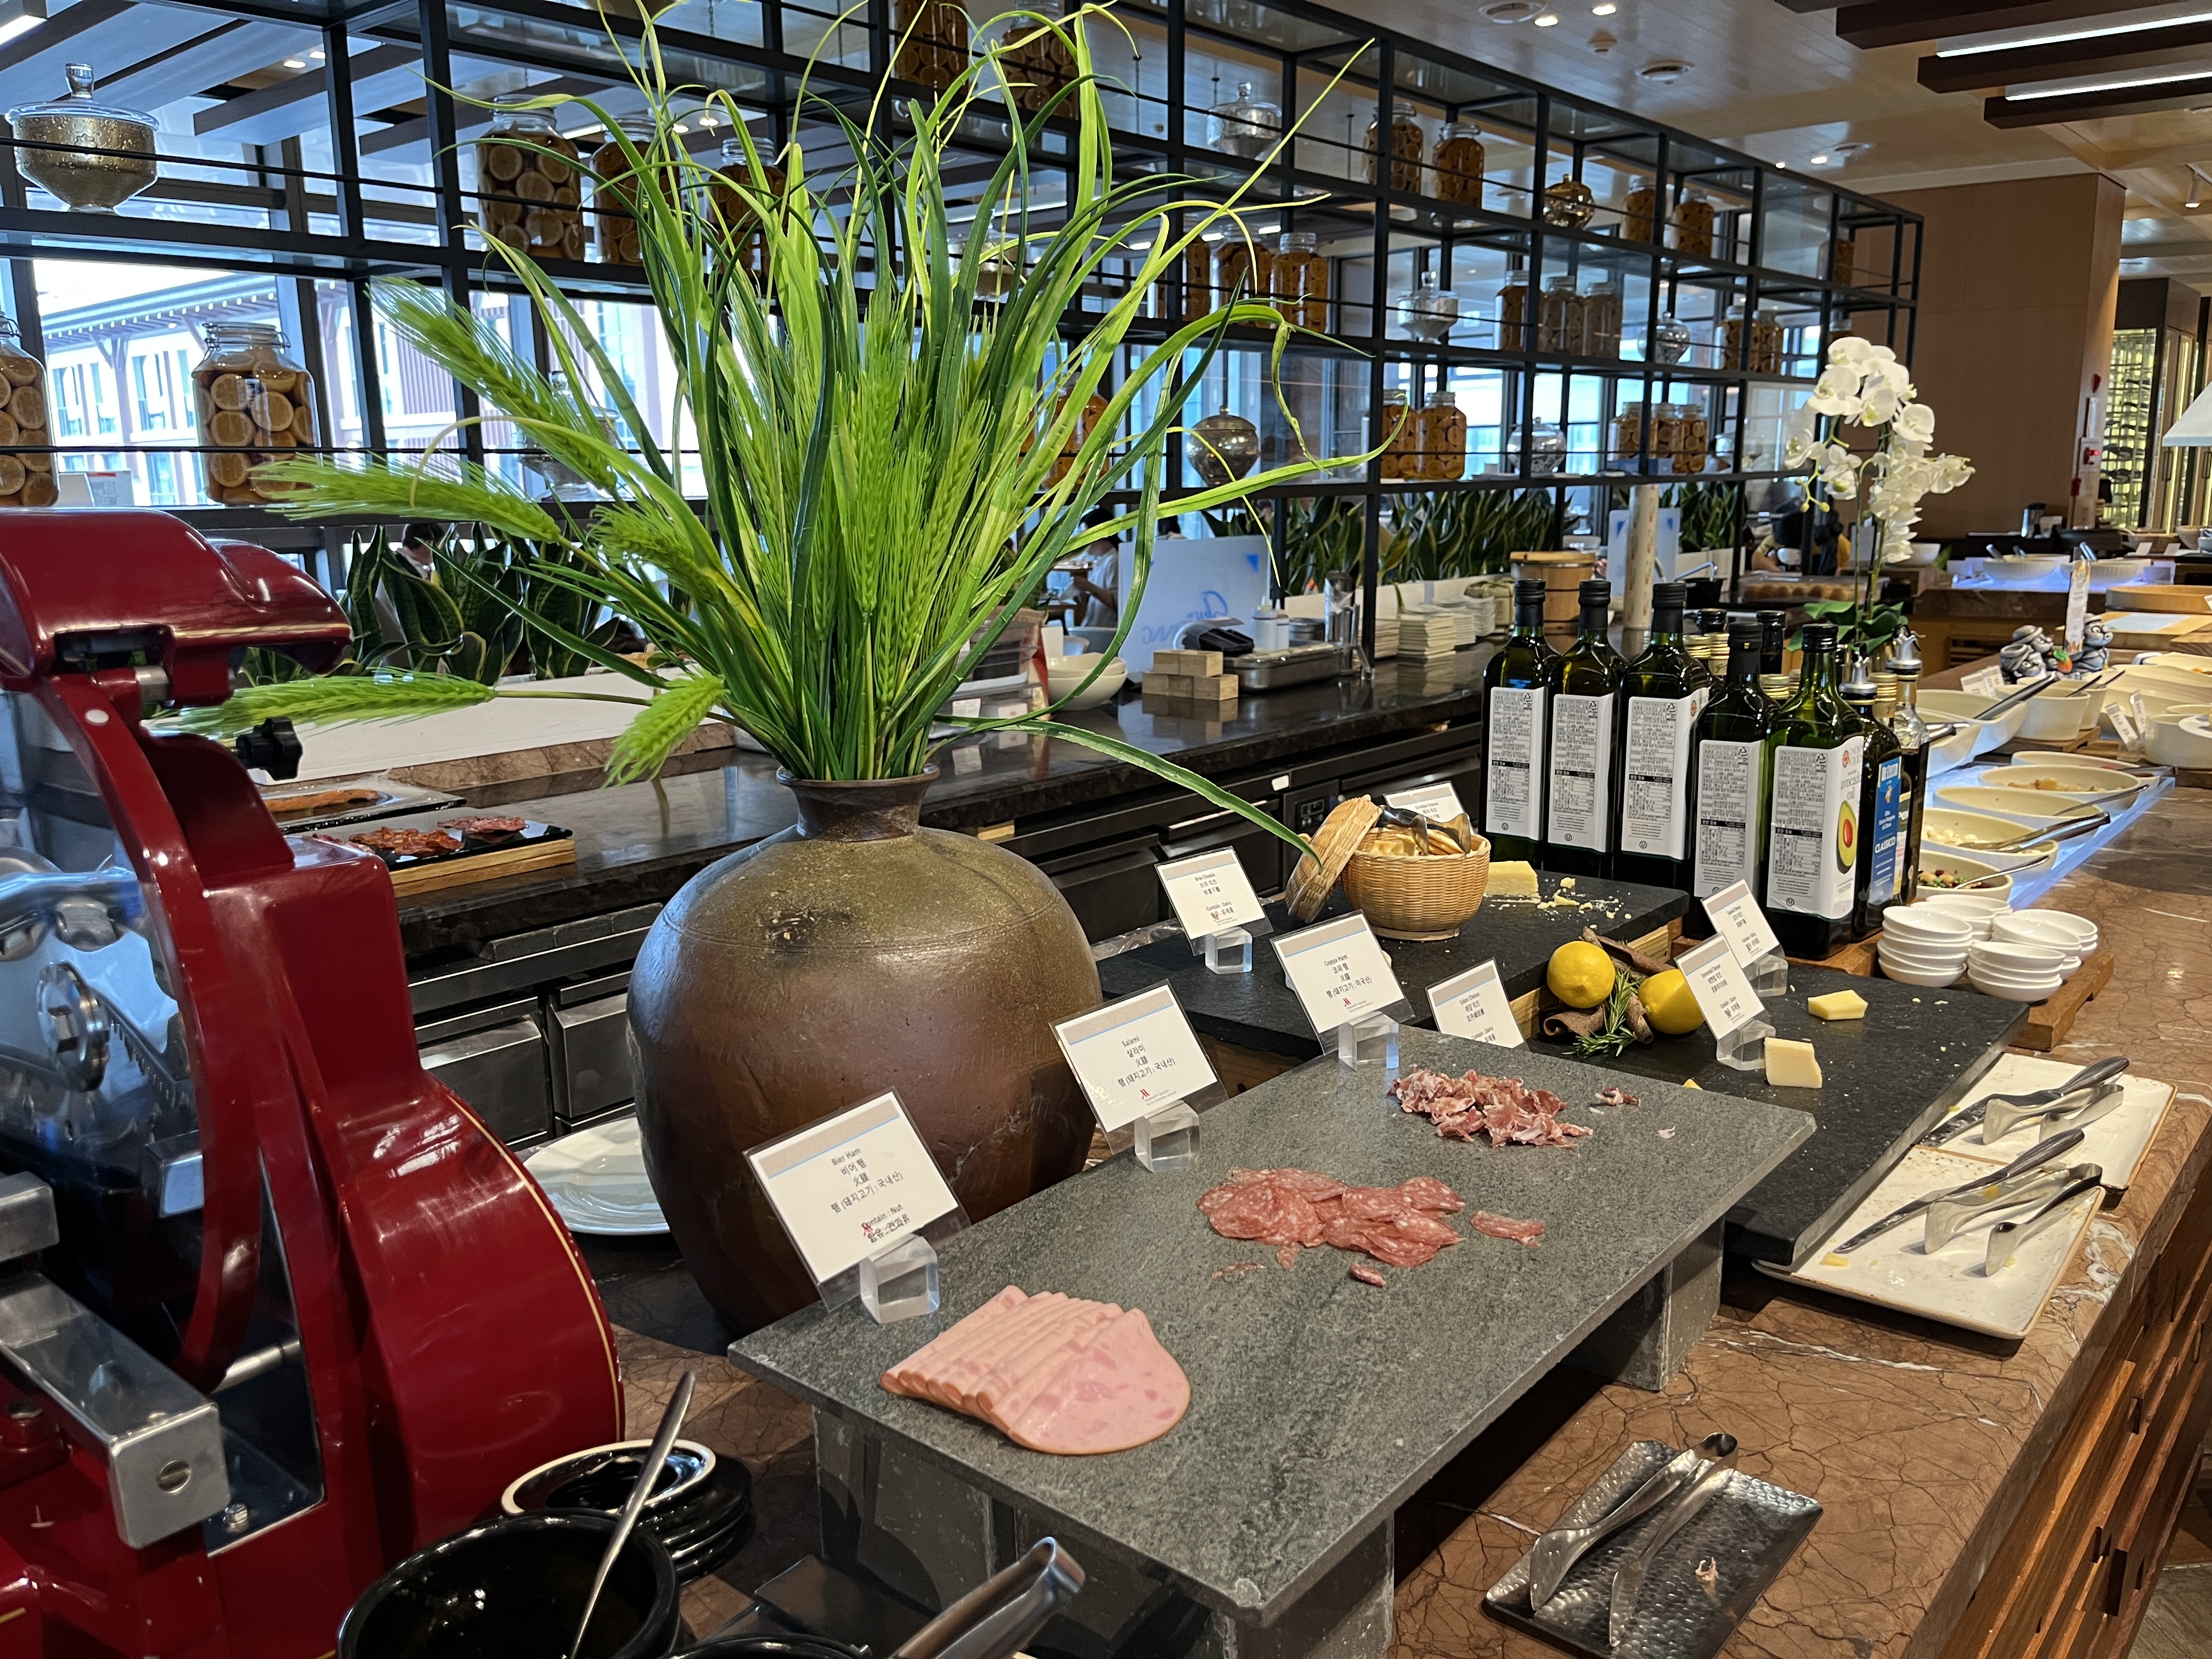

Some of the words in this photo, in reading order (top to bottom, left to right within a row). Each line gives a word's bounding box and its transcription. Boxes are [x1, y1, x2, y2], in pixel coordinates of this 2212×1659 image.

[1847, 786, 1855, 800] oil
[1875, 836, 1896, 854] CLASSICO
[1333, 964, 1343, 974] 코파
[1333, 982, 1354, 996] (돼지고기
[1122, 1035, 1140, 1047] Salami
[1127, 1044, 1146, 1058] 살라미
[1118, 1078, 1126, 1087] 햄
[1125, 1066, 1152, 1085] (돼지고기
[1154, 1058, 1176, 1070] 국내산)
[831, 1155, 845, 1165] Bier
[845, 1148, 861, 1159] Ham
[840, 1162, 858, 1175] 비어
[856, 1158, 866, 1169] 햄
[831, 1202, 841, 1213] 햄
[841, 1184, 874, 1210] (돼지고기
[877, 1171, 904, 1188] 국내산)
[890, 1204, 903, 1214] Nut
